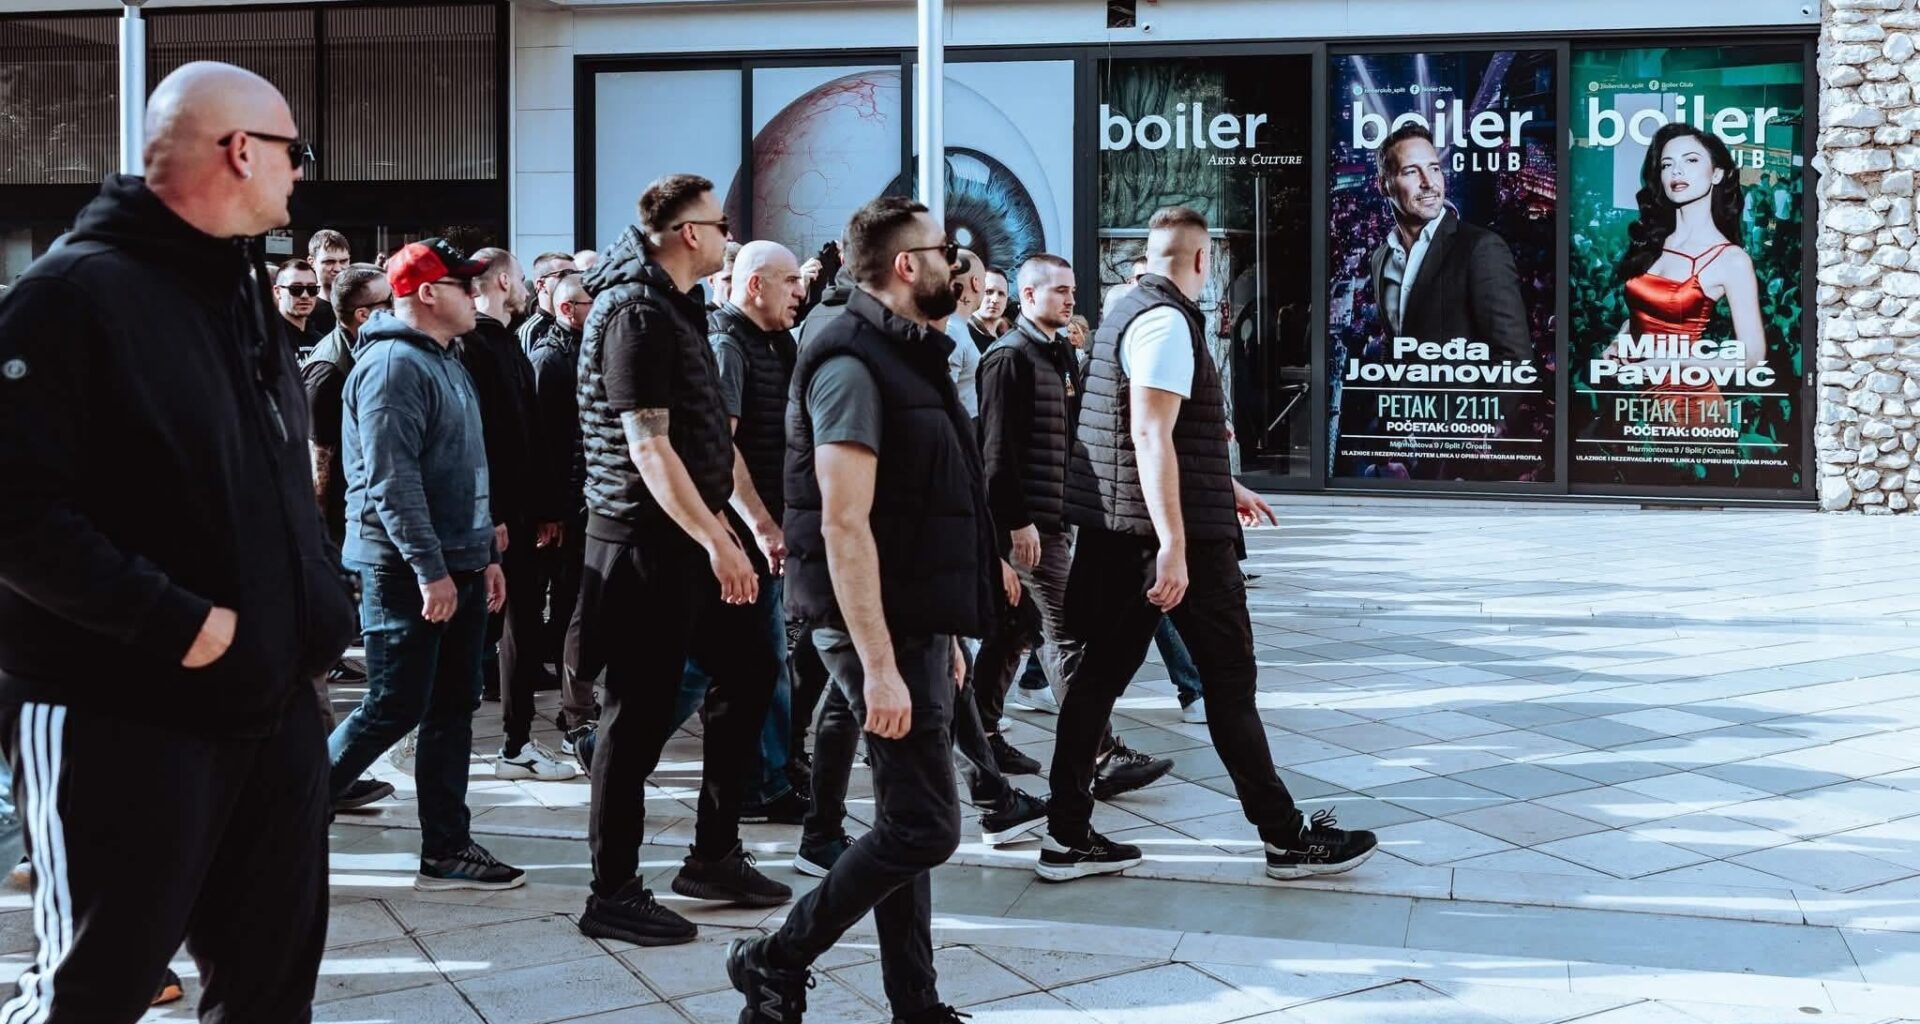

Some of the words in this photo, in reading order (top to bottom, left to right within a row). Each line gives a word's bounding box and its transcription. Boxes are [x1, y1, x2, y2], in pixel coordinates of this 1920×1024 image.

[1099, 102, 1267, 151] boiler
[1239, 156, 1246, 165] &
[1452, 152, 1521, 172] CLUB
[1393, 336, 1490, 360] Peđa
[1618, 334, 1746, 360] Milica
[1346, 358, 1538, 384] Jovanović
[1590, 360, 1776, 387] Pavlović
[1378, 394, 1438, 419] PETAK
[1456, 396, 1505, 420] 21.11.
[1615, 398, 1678, 422] PETAK
[1698, 400, 1748, 424] 14.11.
[1386, 420, 1448, 433] POČETAK:
[1450, 424, 1496, 434] 00:00h
[1624, 424, 1690, 437] POČETAK:
[1692, 427, 1739, 438] 00:00h
[1444, 442, 1460, 450] Split
[1466, 442, 1492, 450] Croatia
[1627, 446, 1673, 454] Marmontova
[1685, 446, 1702, 455] Split
[1707, 446, 1735, 454] Croatia
